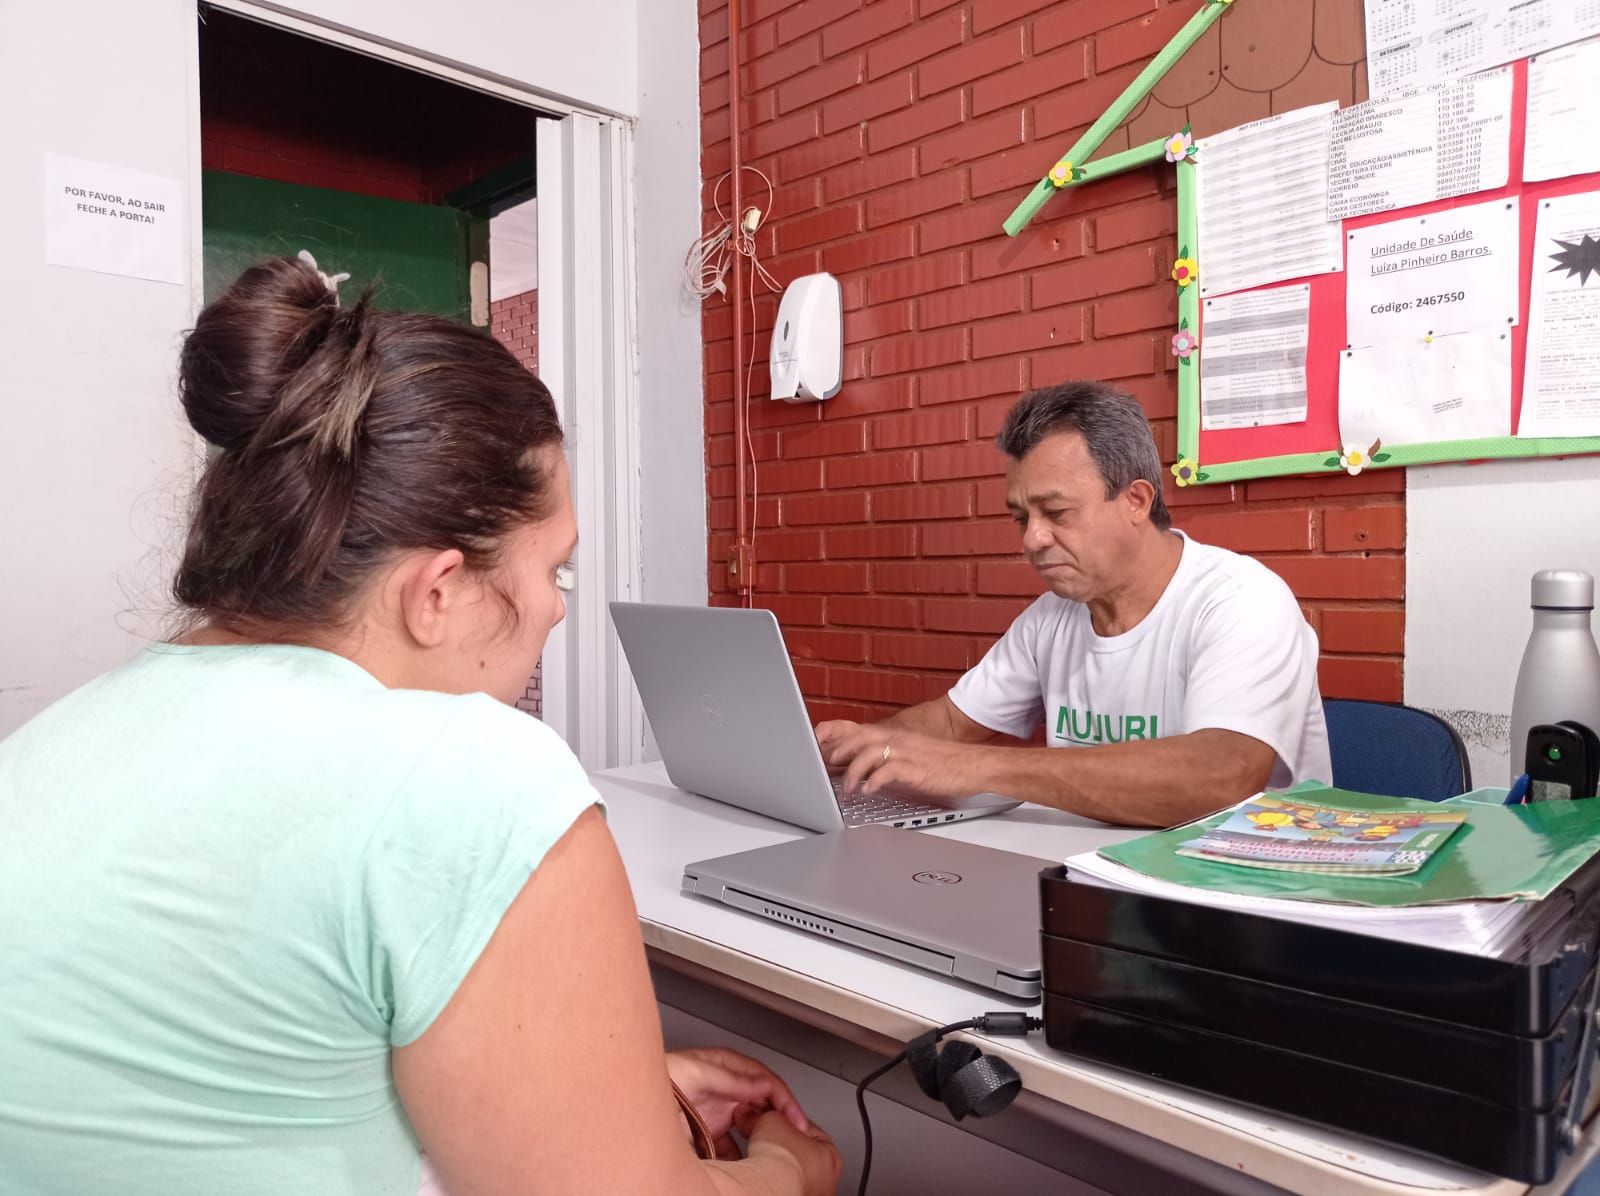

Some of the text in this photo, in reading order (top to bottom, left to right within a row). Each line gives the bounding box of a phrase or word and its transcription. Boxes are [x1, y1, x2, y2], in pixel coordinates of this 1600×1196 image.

[1361, 96, 1390, 110] ESCOLAS
[1427, 82, 1447, 92] CNPJ
[1457, 70, 1500, 85] TELEFONES
[1361, 108, 1375, 117] LIMA
[1366, 108, 1403, 121] BRADESCO
[1353, 127, 1384, 140] LUSTOSA
[1331, 151, 1347, 159] CNPJ
[1331, 158, 1347, 166] CRAS
[1330, 166, 1369, 180] PREFEITURA
[1329, 183, 1359, 193] CORREIO
[65, 186, 165, 212] POR FAVOR, AO SAIR
[1329, 199, 1348, 207] CAIXA
[1329, 206, 1348, 214] CAIXA
[1349, 198, 1385, 210] GESTORES
[77, 203, 155, 224] FECHE A PORTA!
[1329, 212, 1348, 221] CAIXA
[1371, 229, 1473, 257] Unidade De Saúde
[1401, 253, 1447, 268] Pinheiro
[1450, 245, 1492, 260] Barros.
[1370, 291, 1465, 314] Código: 2467550
